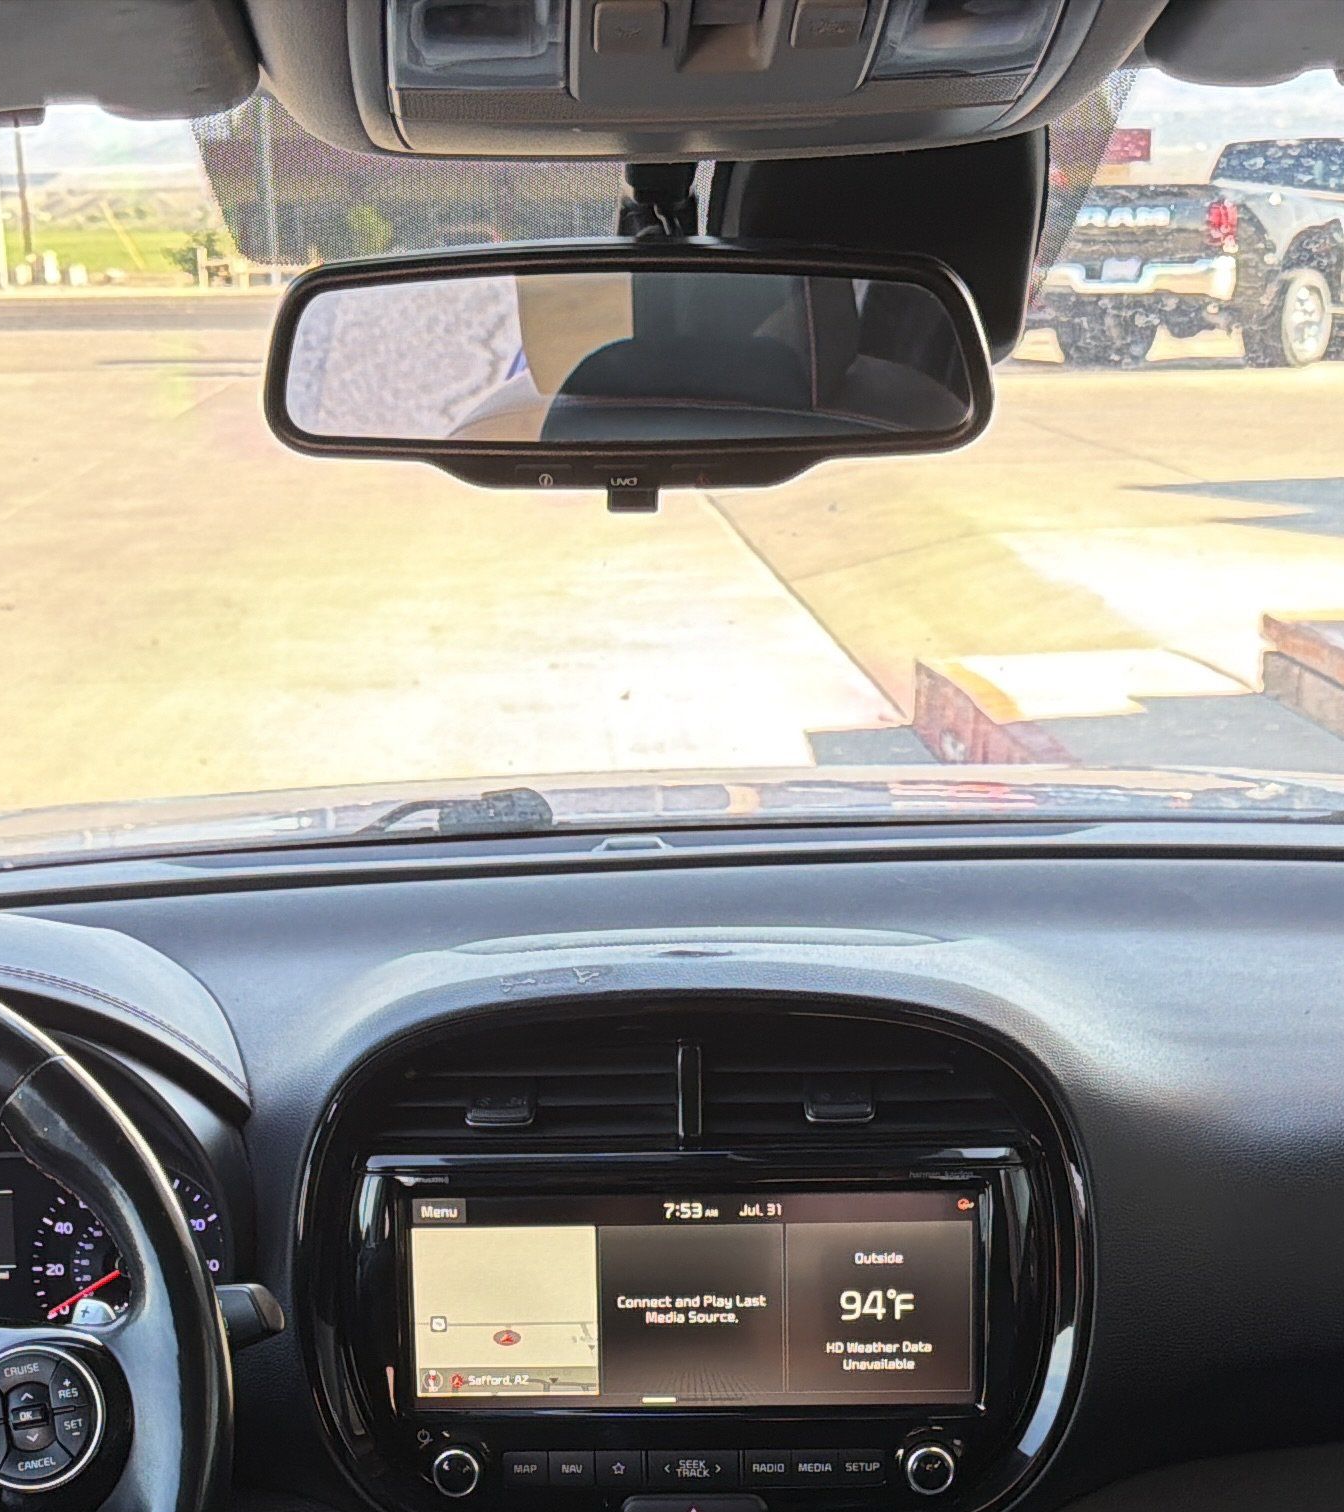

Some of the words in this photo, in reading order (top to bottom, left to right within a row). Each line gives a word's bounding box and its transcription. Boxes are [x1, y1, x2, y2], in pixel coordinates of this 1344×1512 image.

[420, 1206, 457, 1218] Menu
[663, 1203, 703, 1219] 7:53
[766, 1203, 782, 1216] 31
[54, 1222, 74, 1235] 40
[854, 1252, 904, 1264] Outside
[46, 1263, 65, 1277] 20
[617, 1296, 672, 1309] Connect
[674, 1295, 700, 1308] and
[703, 1295, 733, 1309] Play
[735, 1294, 767, 1308] Last
[840, 1288, 914, 1321] 94°F
[645, 1311, 685, 1324] Media
[826, 1342, 844, 1354] HD
[846, 1341, 901, 1354] Weather
[902, 1341, 933, 1353] Data
[3, 1363, 40, 1378] CRUISE
[843, 1359, 916, 1371] Unavailable
[514, 1375, 530, 1385] AZ
[58, 1387, 79, 1399] RES
[19, 1411, 33, 1421] OK
[63, 1418, 83, 1430] SET
[17, 1456, 57, 1472] CANCEL
[513, 1464, 538, 1474] MAP
[561, 1464, 583, 1474] NAV
[679, 1460, 706, 1470] SEEK
[752, 1463, 785, 1473] RADIO
[798, 1462, 832, 1472] MEDIA
[845, 1462, 880, 1472] SETUP
[676, 1468, 711, 1478] TRACK
